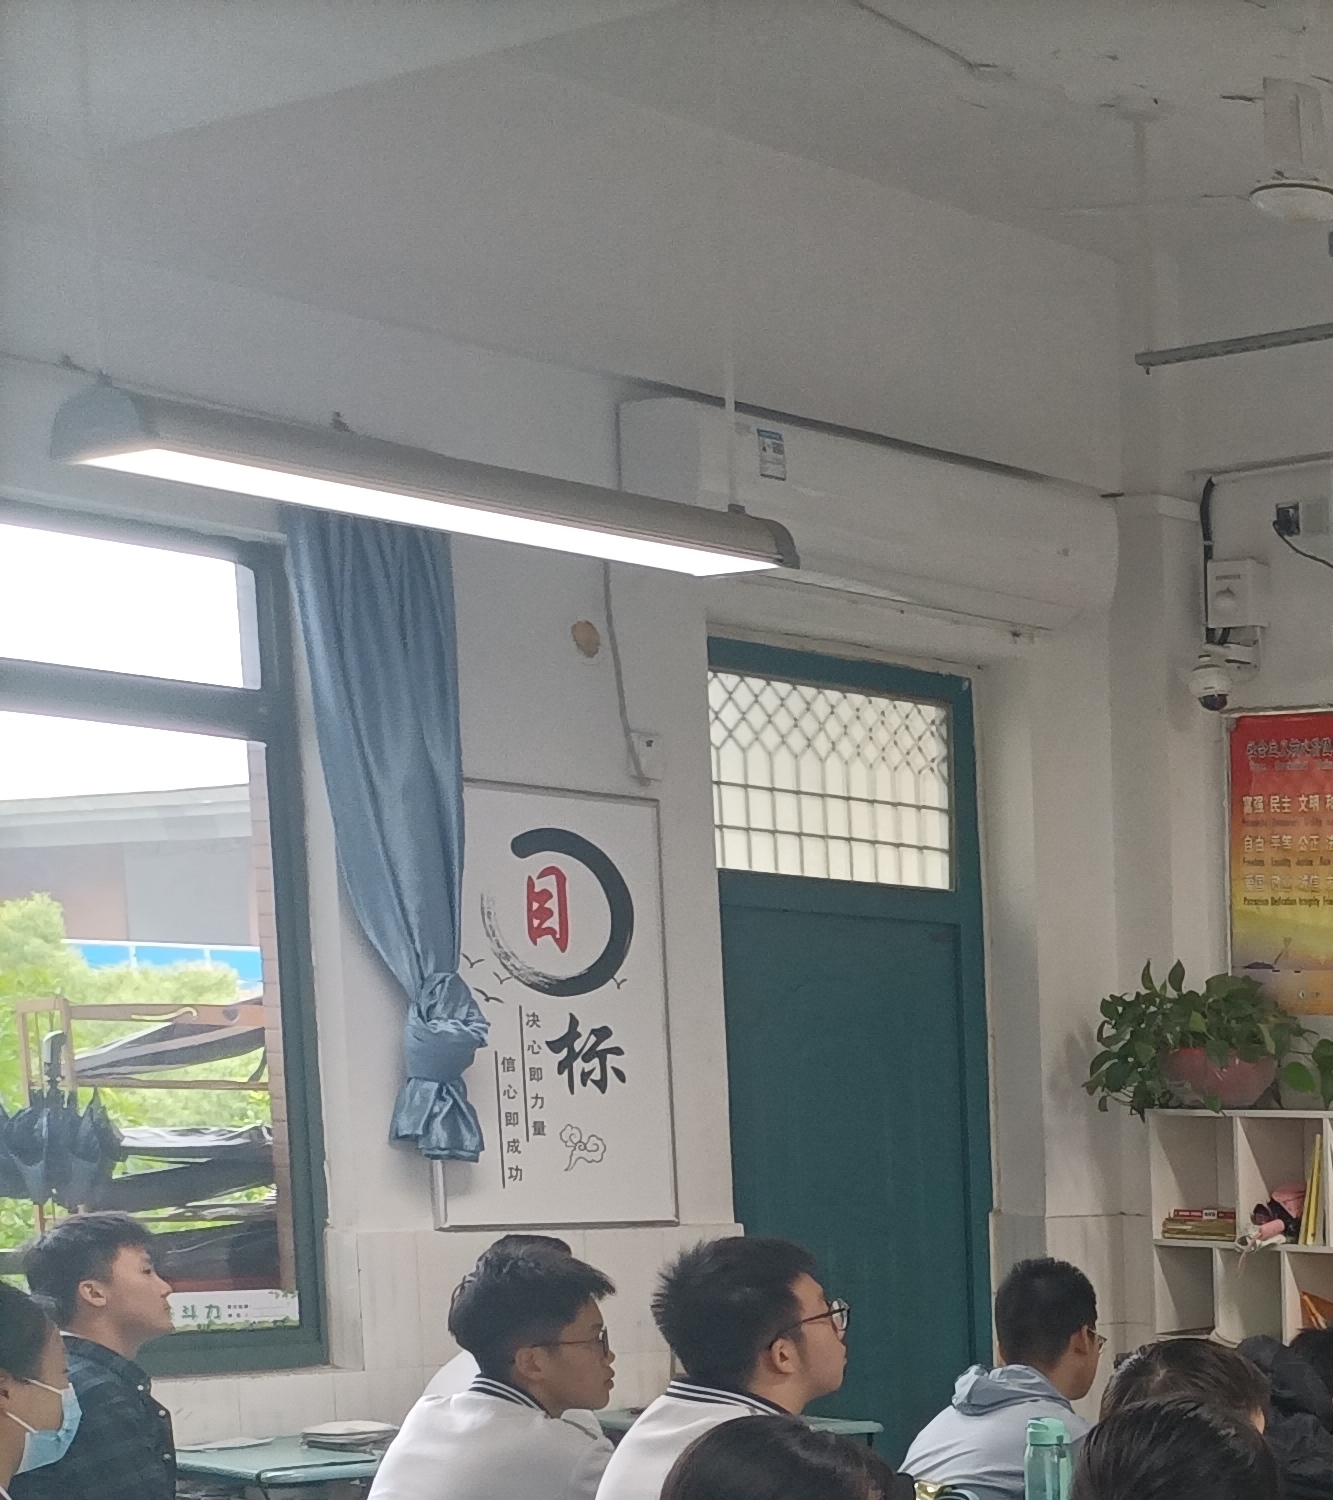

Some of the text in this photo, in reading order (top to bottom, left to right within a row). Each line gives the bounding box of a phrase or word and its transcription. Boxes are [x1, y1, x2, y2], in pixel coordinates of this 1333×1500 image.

[1269, 795, 1292, 814] 民主
[500, 1056, 523, 1182] 信心即成功
[525, 1011, 547, 1137] 决心即力量
